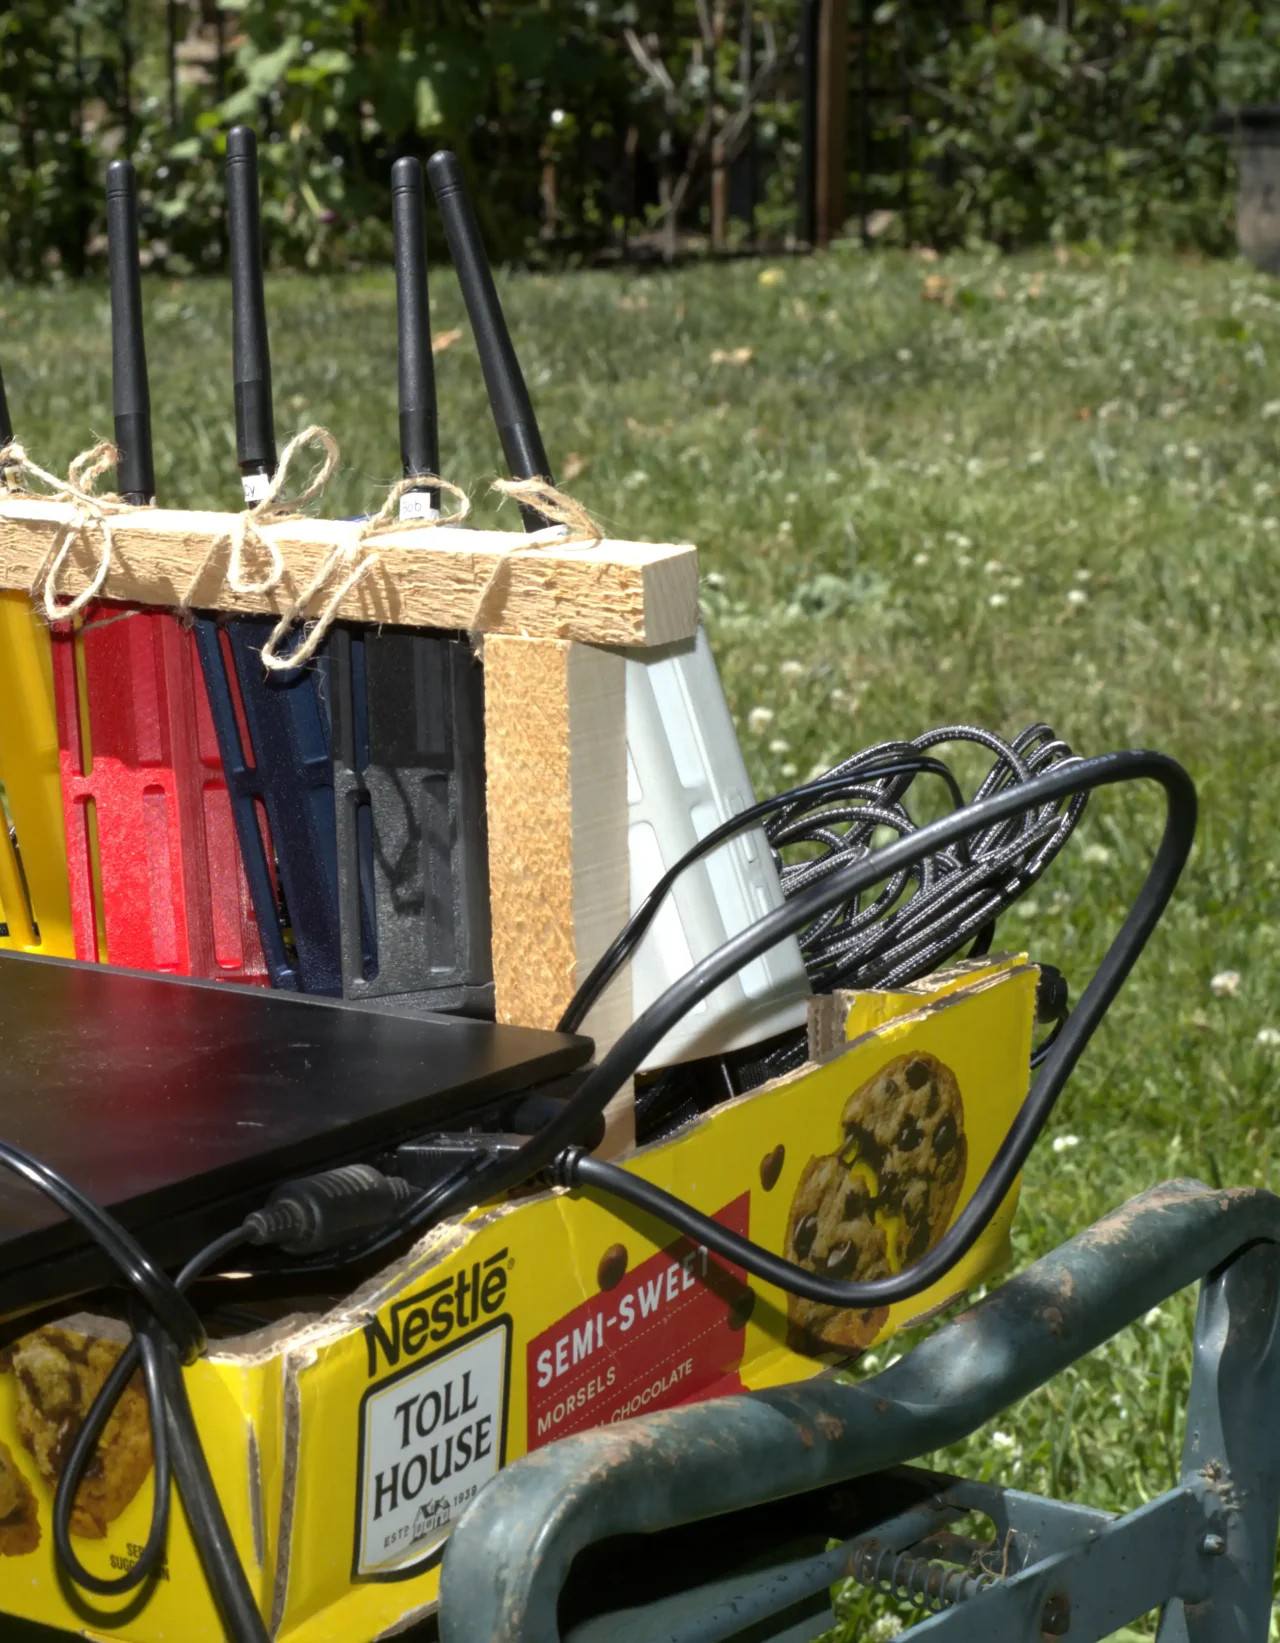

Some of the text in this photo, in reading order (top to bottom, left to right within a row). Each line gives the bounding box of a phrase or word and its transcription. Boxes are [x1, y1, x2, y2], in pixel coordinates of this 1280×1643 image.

[535, 1244, 708, 1389] SEMI-SWEET
[394, 1369, 479, 1450] TOLL
[537, 1365, 617, 1437] MORSELS
[610, 1357, 694, 1424] CHOCOLATE
[373, 1414, 492, 1521] HOUSE
[453, 1484, 478, 1506] 1939
